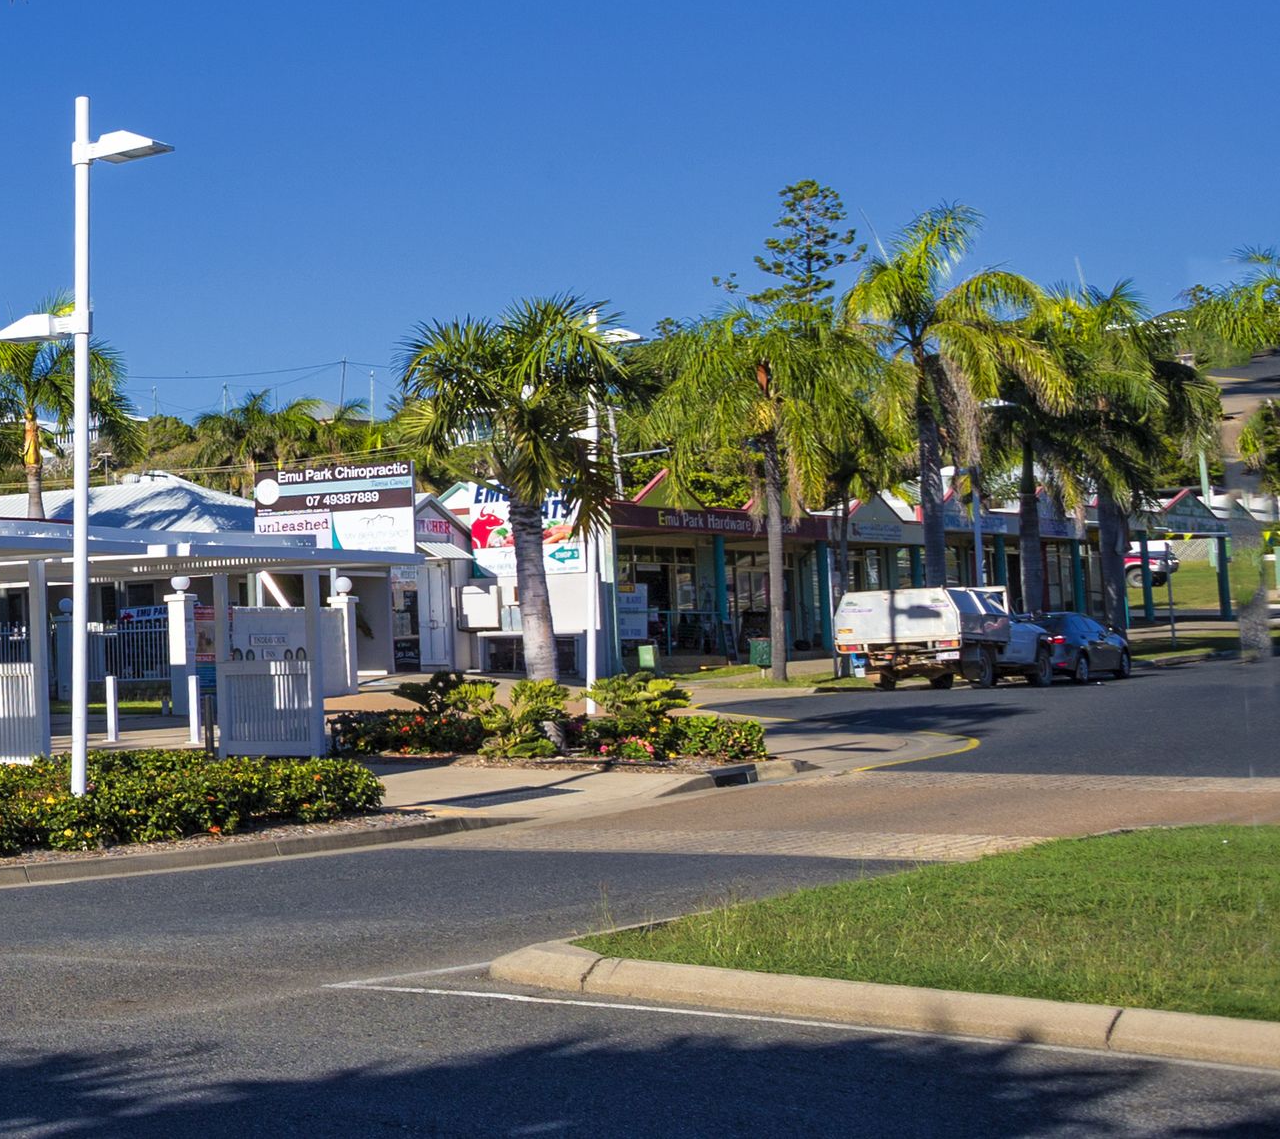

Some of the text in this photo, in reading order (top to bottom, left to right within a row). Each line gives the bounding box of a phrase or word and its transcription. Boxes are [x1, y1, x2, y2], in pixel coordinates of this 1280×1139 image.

[277, 462, 409, 484] Emu Park Chiropractic
[306, 491, 380, 507] 07 49387889
[259, 518, 330, 534] unleashed
[416, 519, 452, 535] TCHER
[658, 511, 679, 527] Emu
[682, 513, 704, 528] Park
[707, 514, 751, 532] Hardware
